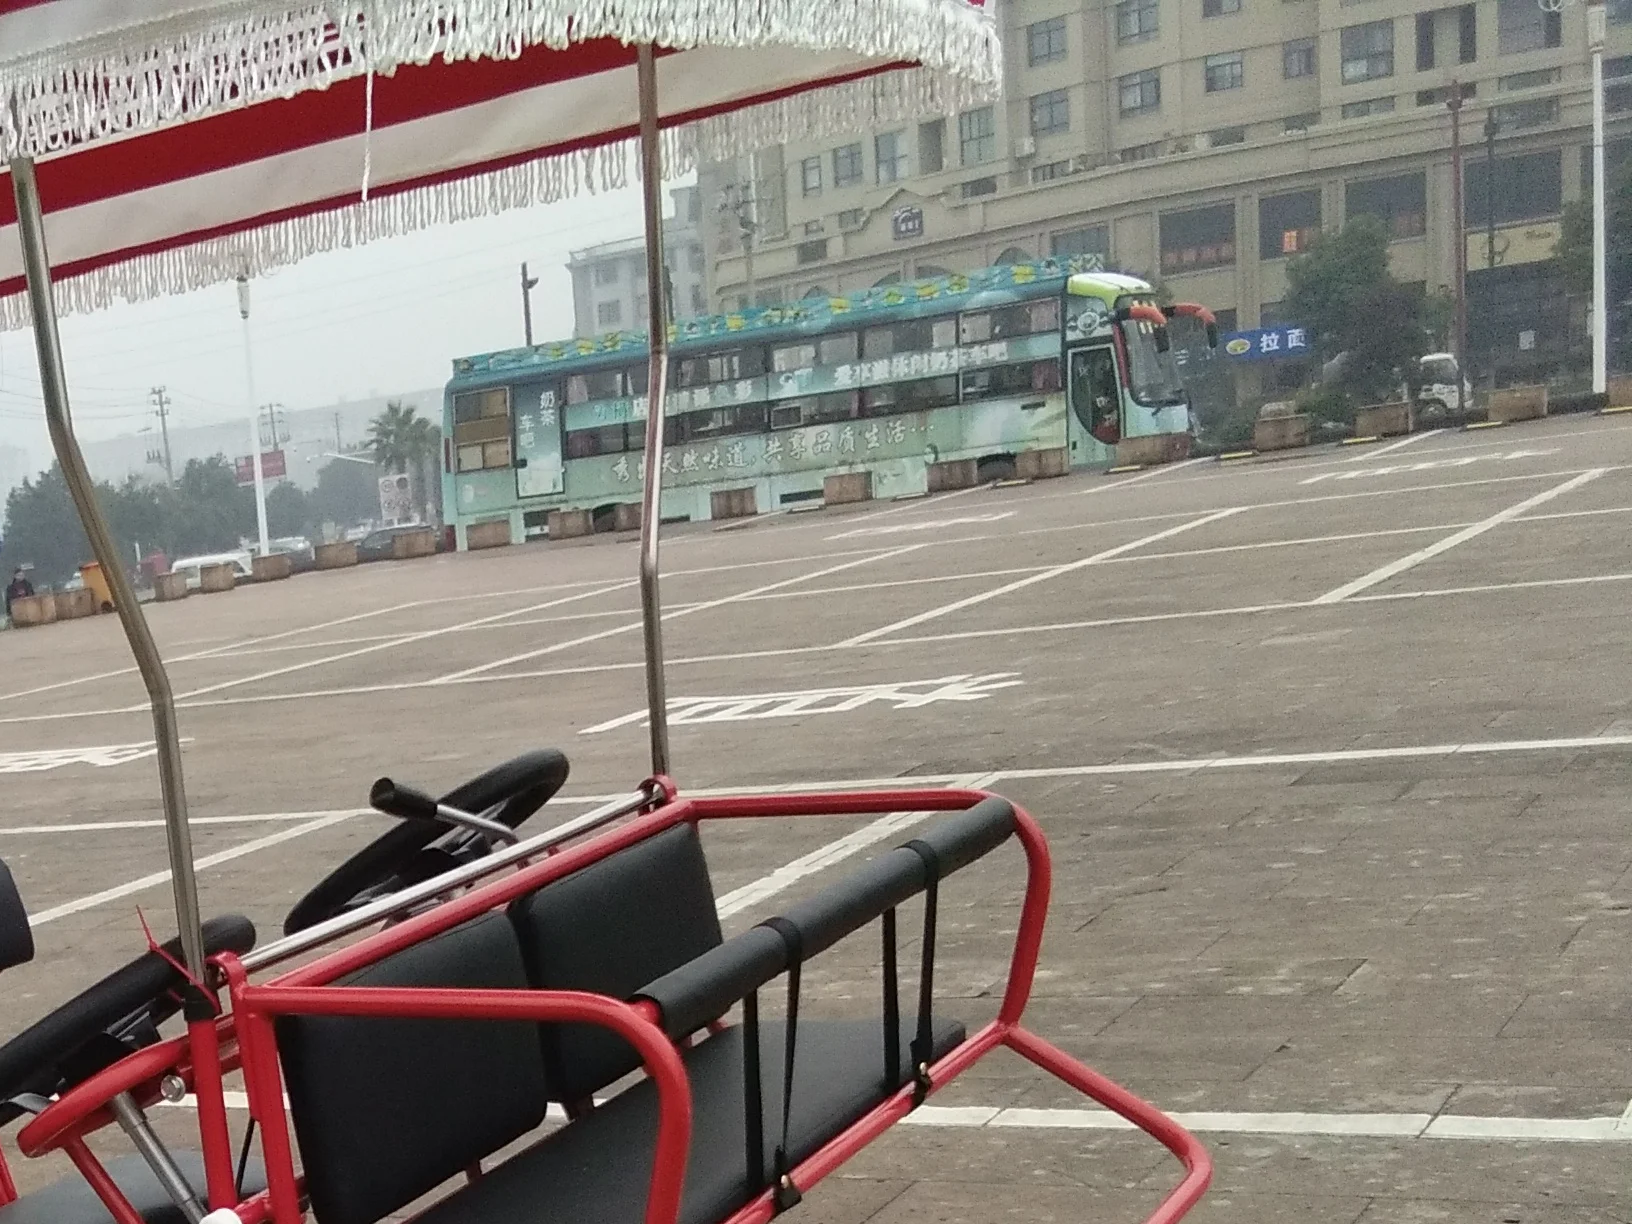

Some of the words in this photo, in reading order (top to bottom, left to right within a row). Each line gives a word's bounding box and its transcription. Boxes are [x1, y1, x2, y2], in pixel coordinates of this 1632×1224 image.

[1260, 328, 1306, 353] 拉面
[540, 391, 555, 426] 奶茶
[519, 414, 535, 448] 车吧
